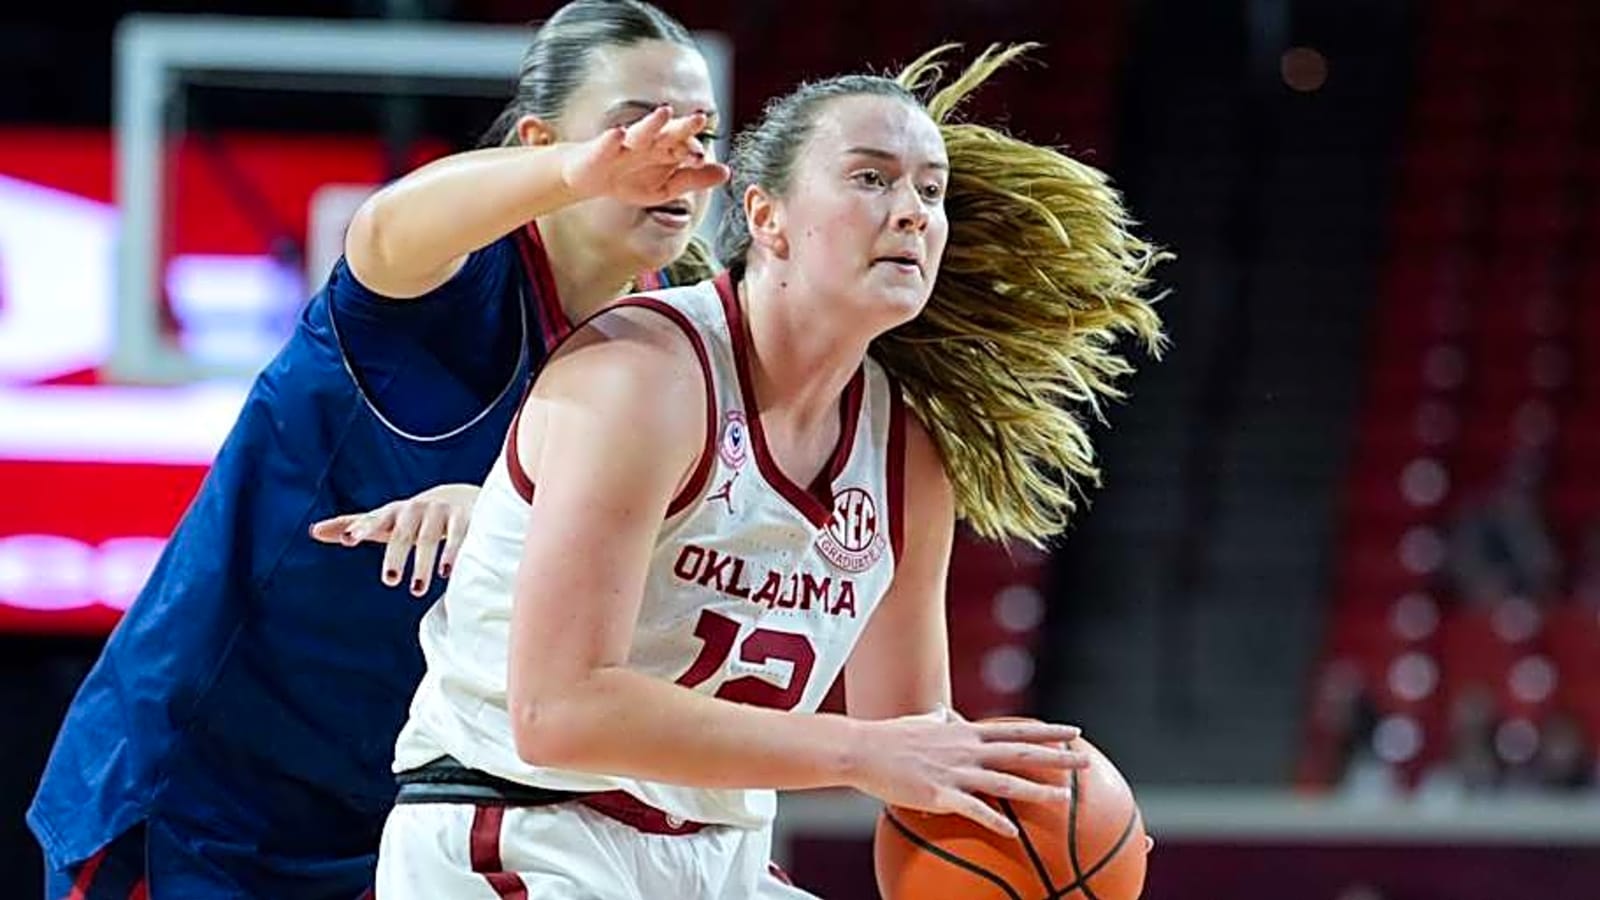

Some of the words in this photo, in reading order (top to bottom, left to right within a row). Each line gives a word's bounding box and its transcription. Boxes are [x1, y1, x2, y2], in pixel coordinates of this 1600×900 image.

[829, 492, 876, 549] SEC
[674, 545, 856, 618] OKLAOMA
[674, 609, 815, 711] 12
